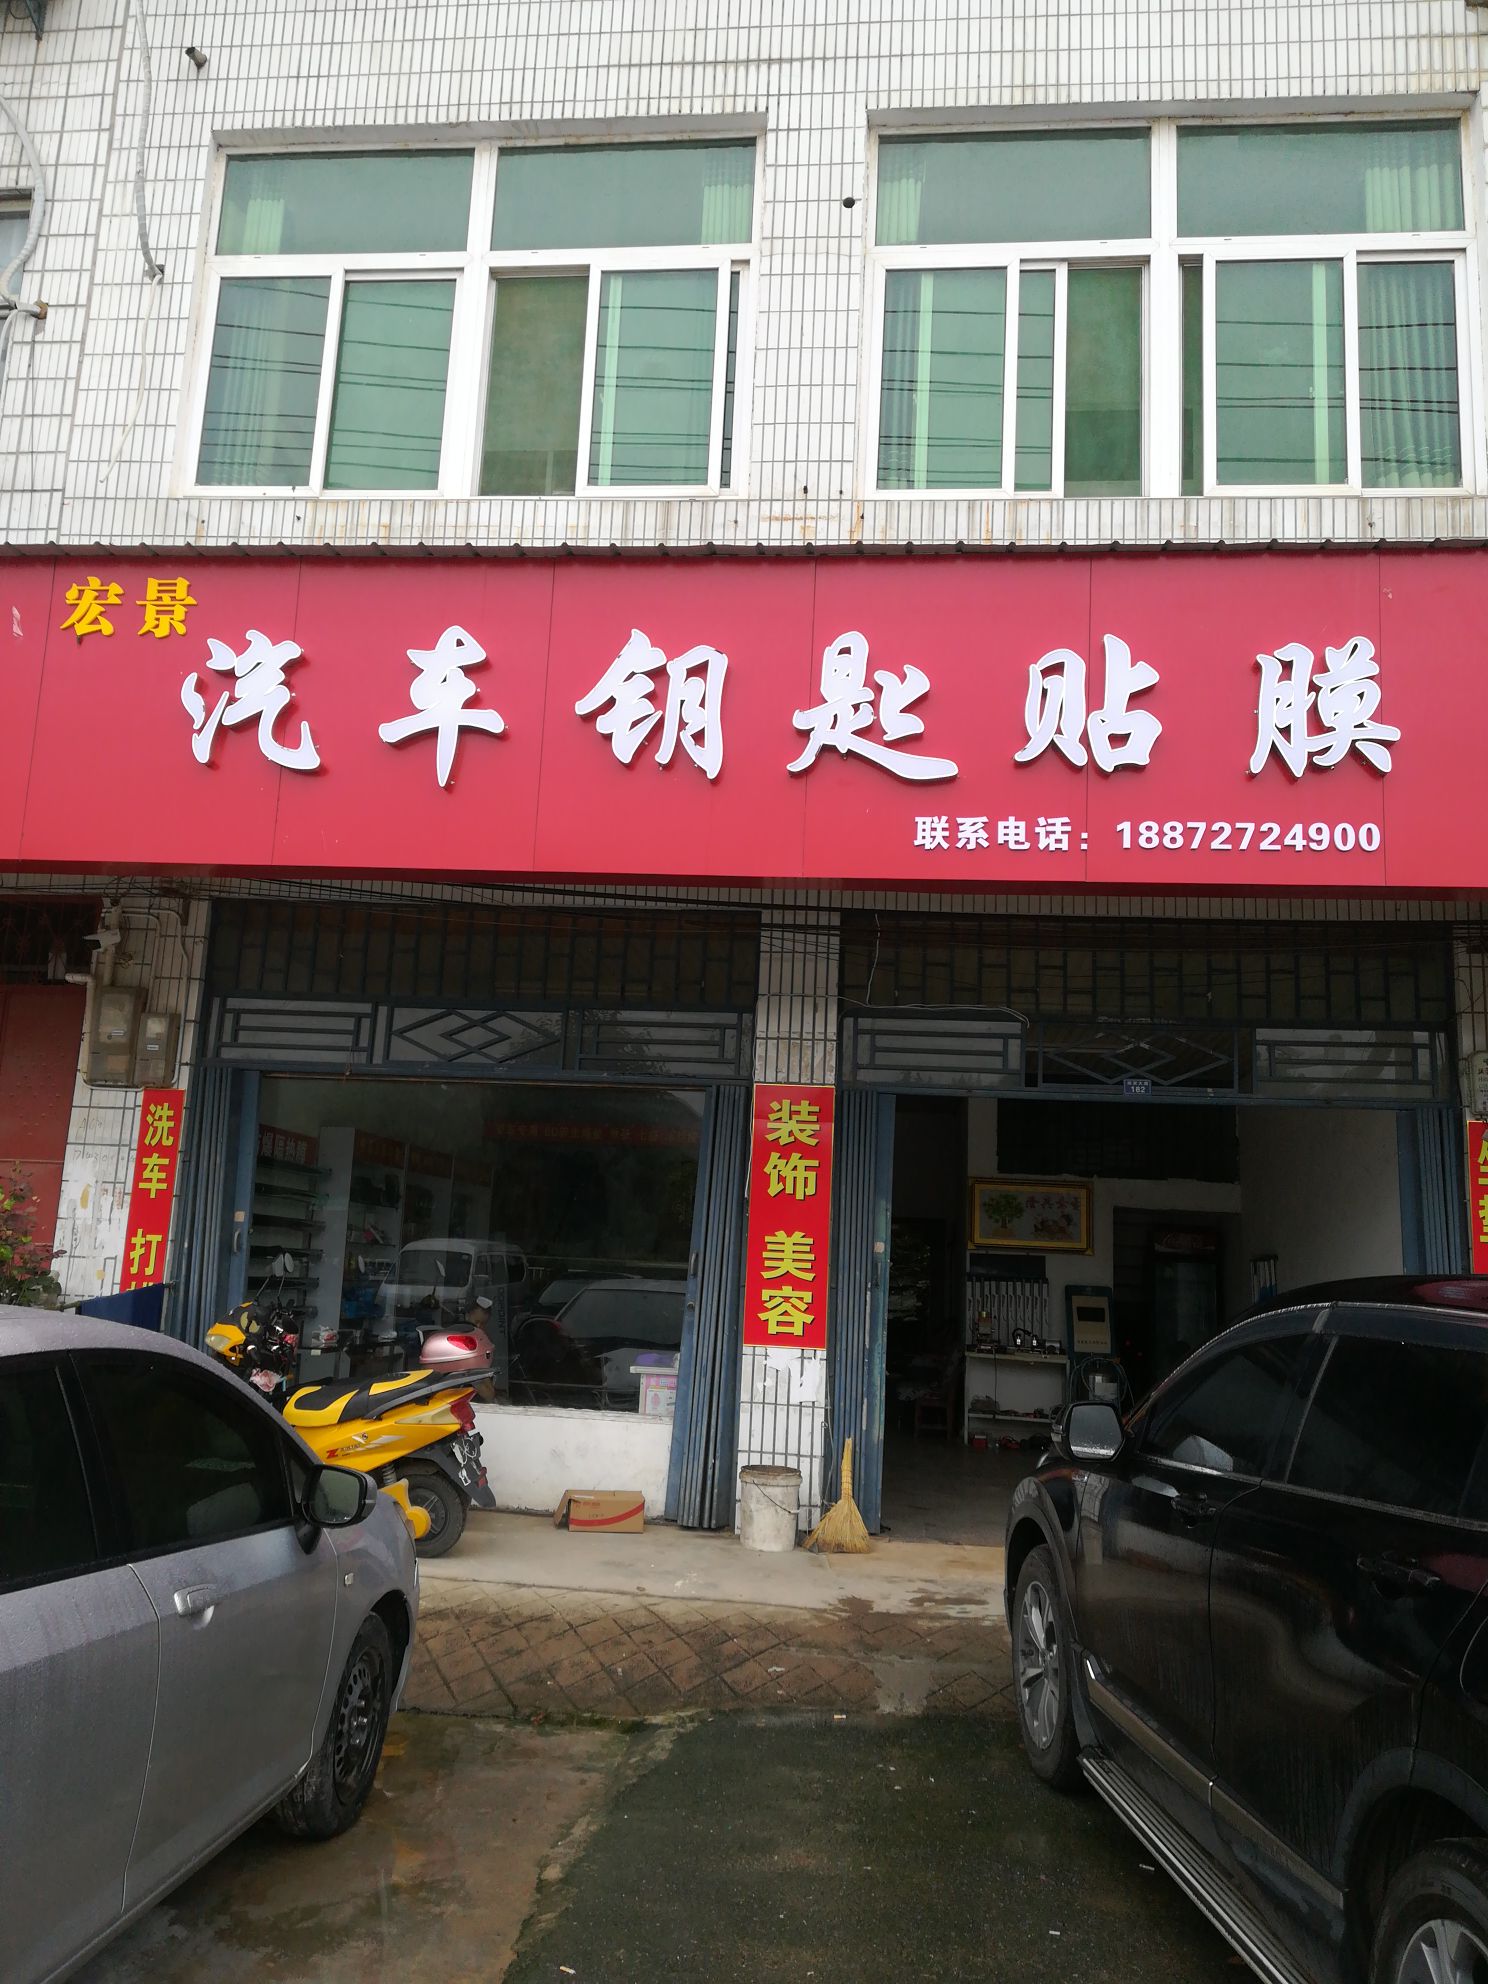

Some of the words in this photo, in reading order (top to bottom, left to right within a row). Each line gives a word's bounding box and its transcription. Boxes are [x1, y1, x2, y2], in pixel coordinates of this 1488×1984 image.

[60, 576, 198, 638] 宏景
[181, 625, 1401, 787] 汽车钥匙贴膜
[1116, 820, 1382, 852] 18872724900
[138, 1102, 175, 1199] 洗车
[764, 1099, 820, 1200] 装饰
[758, 1230, 815, 1336] 美容
